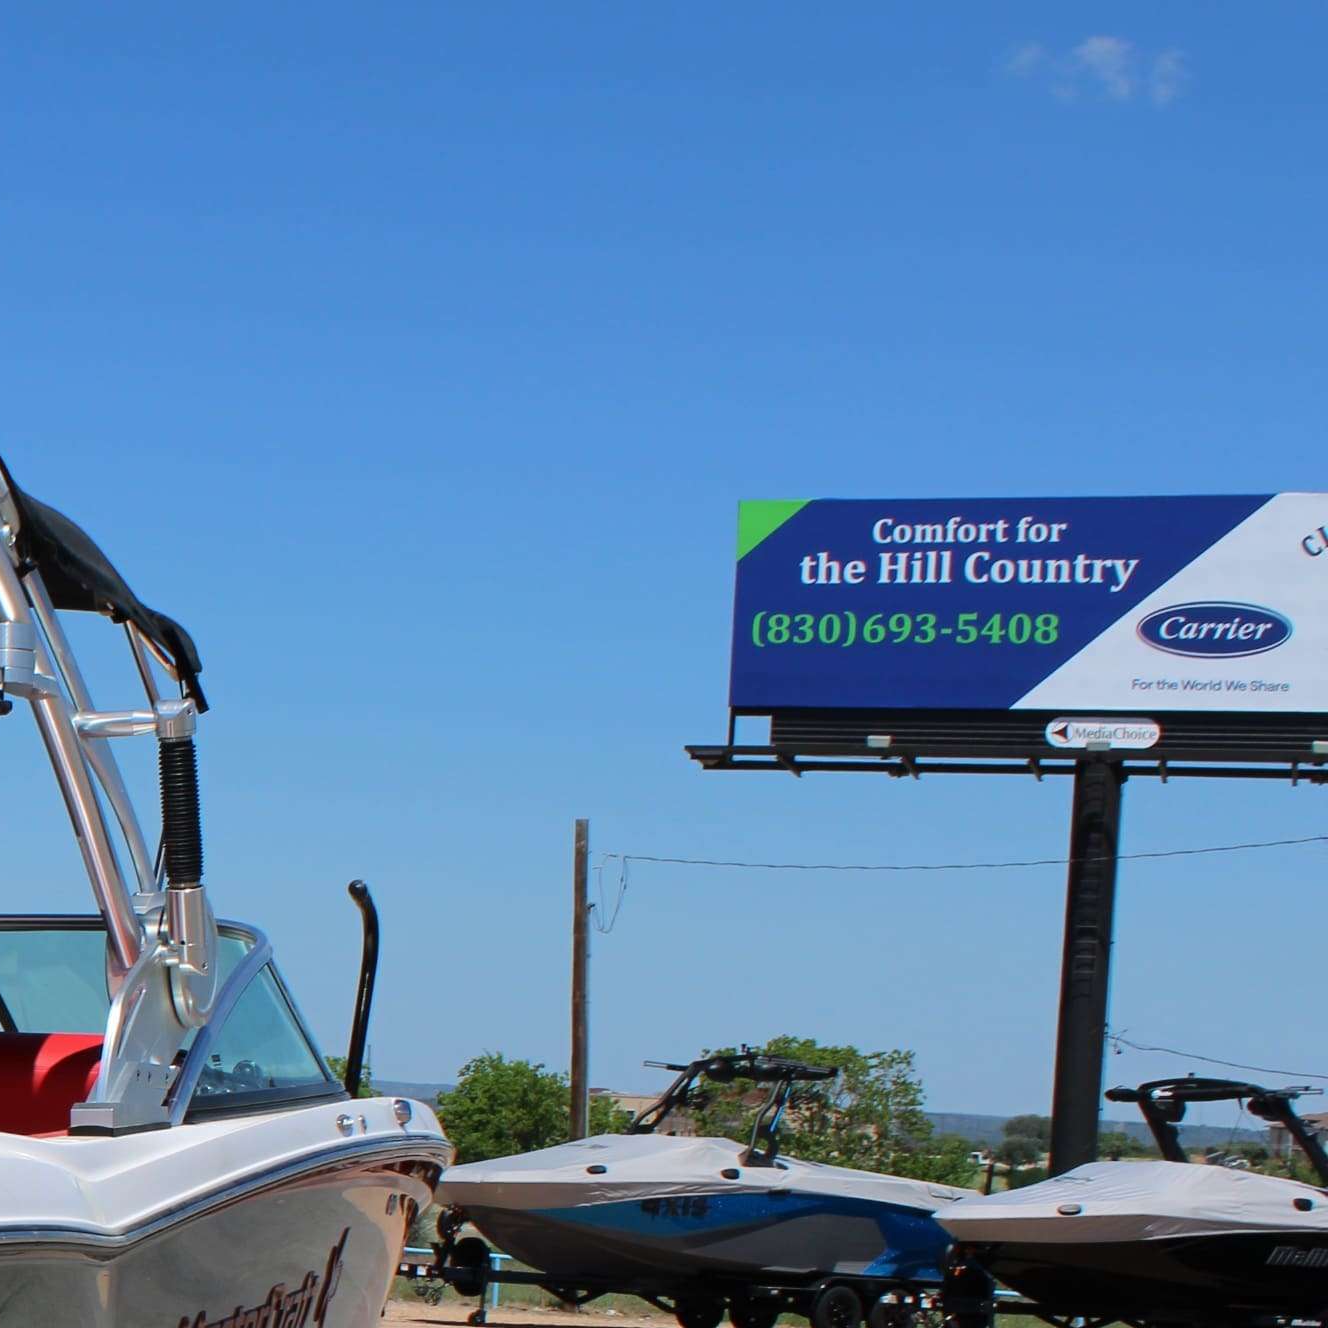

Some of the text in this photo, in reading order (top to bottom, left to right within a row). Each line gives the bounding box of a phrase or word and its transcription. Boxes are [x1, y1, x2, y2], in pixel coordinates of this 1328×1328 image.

[872, 516, 1067, 544] Comfort for
[799, 551, 1139, 592] the Hill Country
[751, 611, 1060, 647] (830)693-5408
[1159, 616, 1273, 640] Carrier
[1131, 679, 1290, 692] For the World We Share
[1075, 727, 1157, 740] MediaChoice
